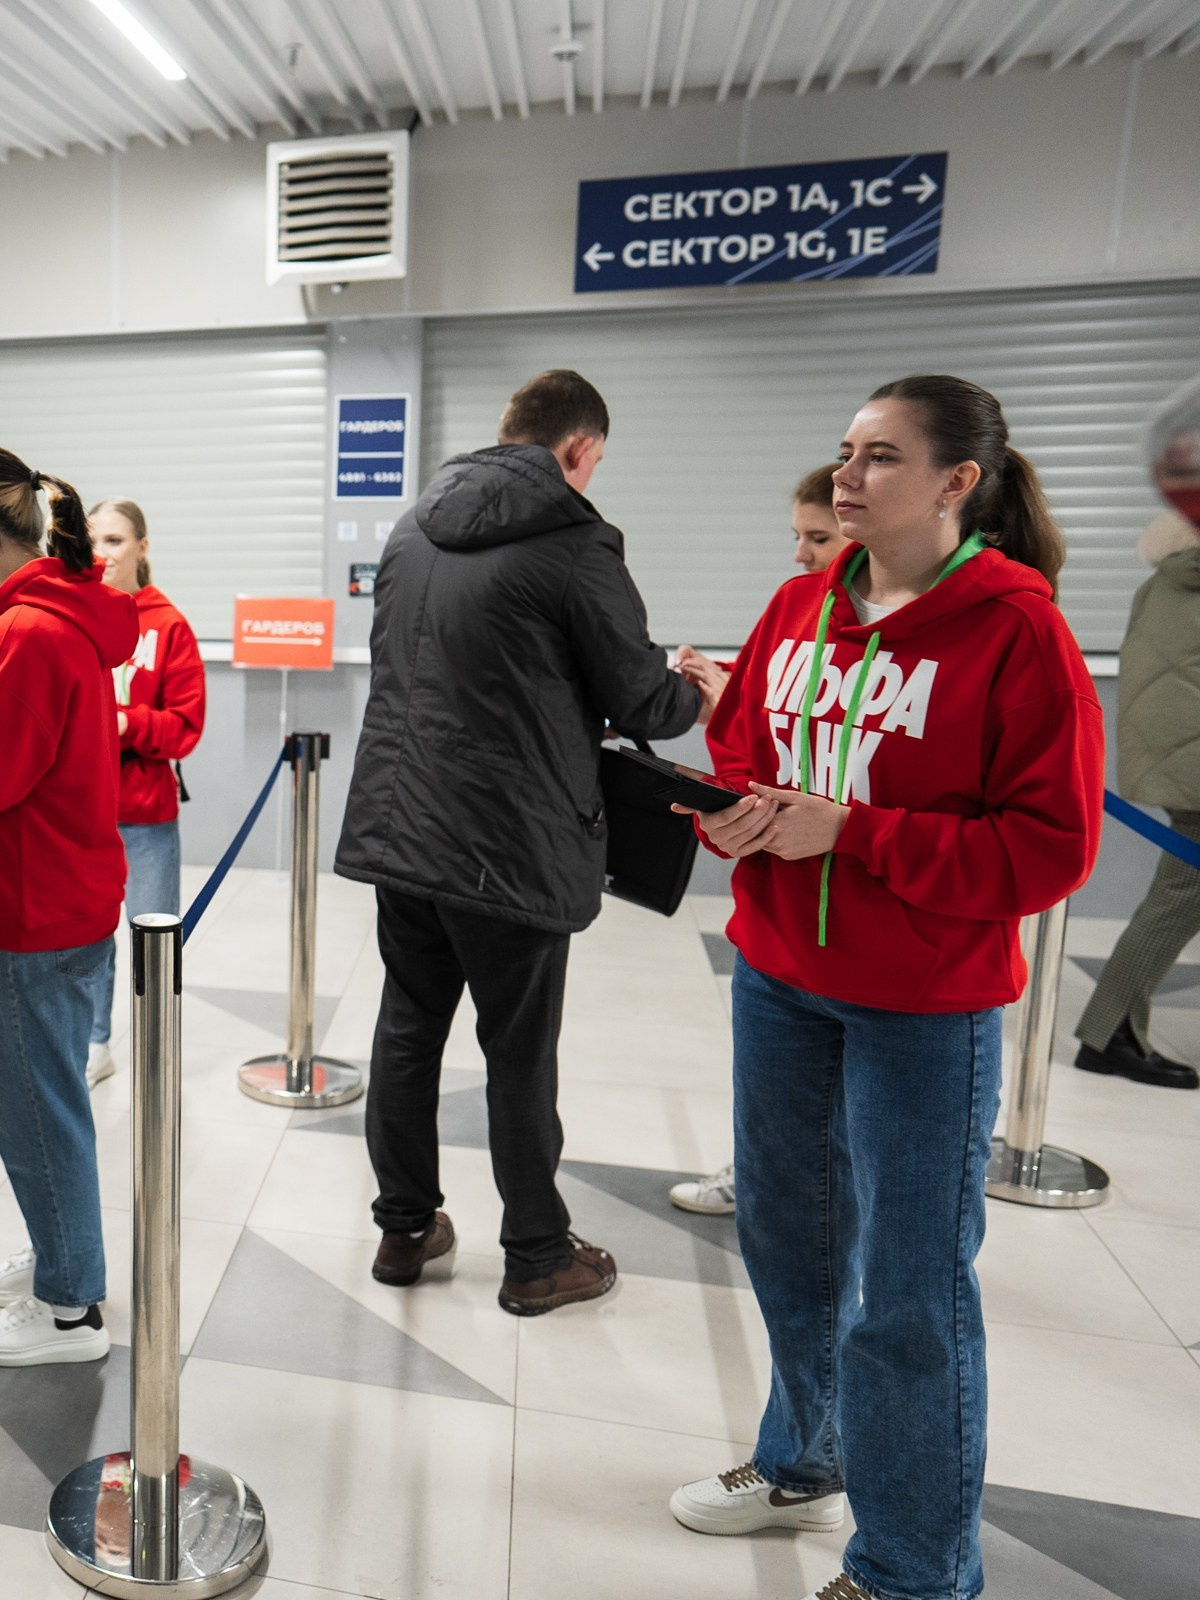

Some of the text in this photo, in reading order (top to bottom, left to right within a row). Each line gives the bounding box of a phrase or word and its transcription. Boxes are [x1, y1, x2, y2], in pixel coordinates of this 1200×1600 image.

[622, 177, 895, 223] СЕКТОР 1A, 1C
[621, 225, 888, 269] СЕКТОР 1G, 1E
[241, 619, 326, 637] ГАРДЕРОБ
